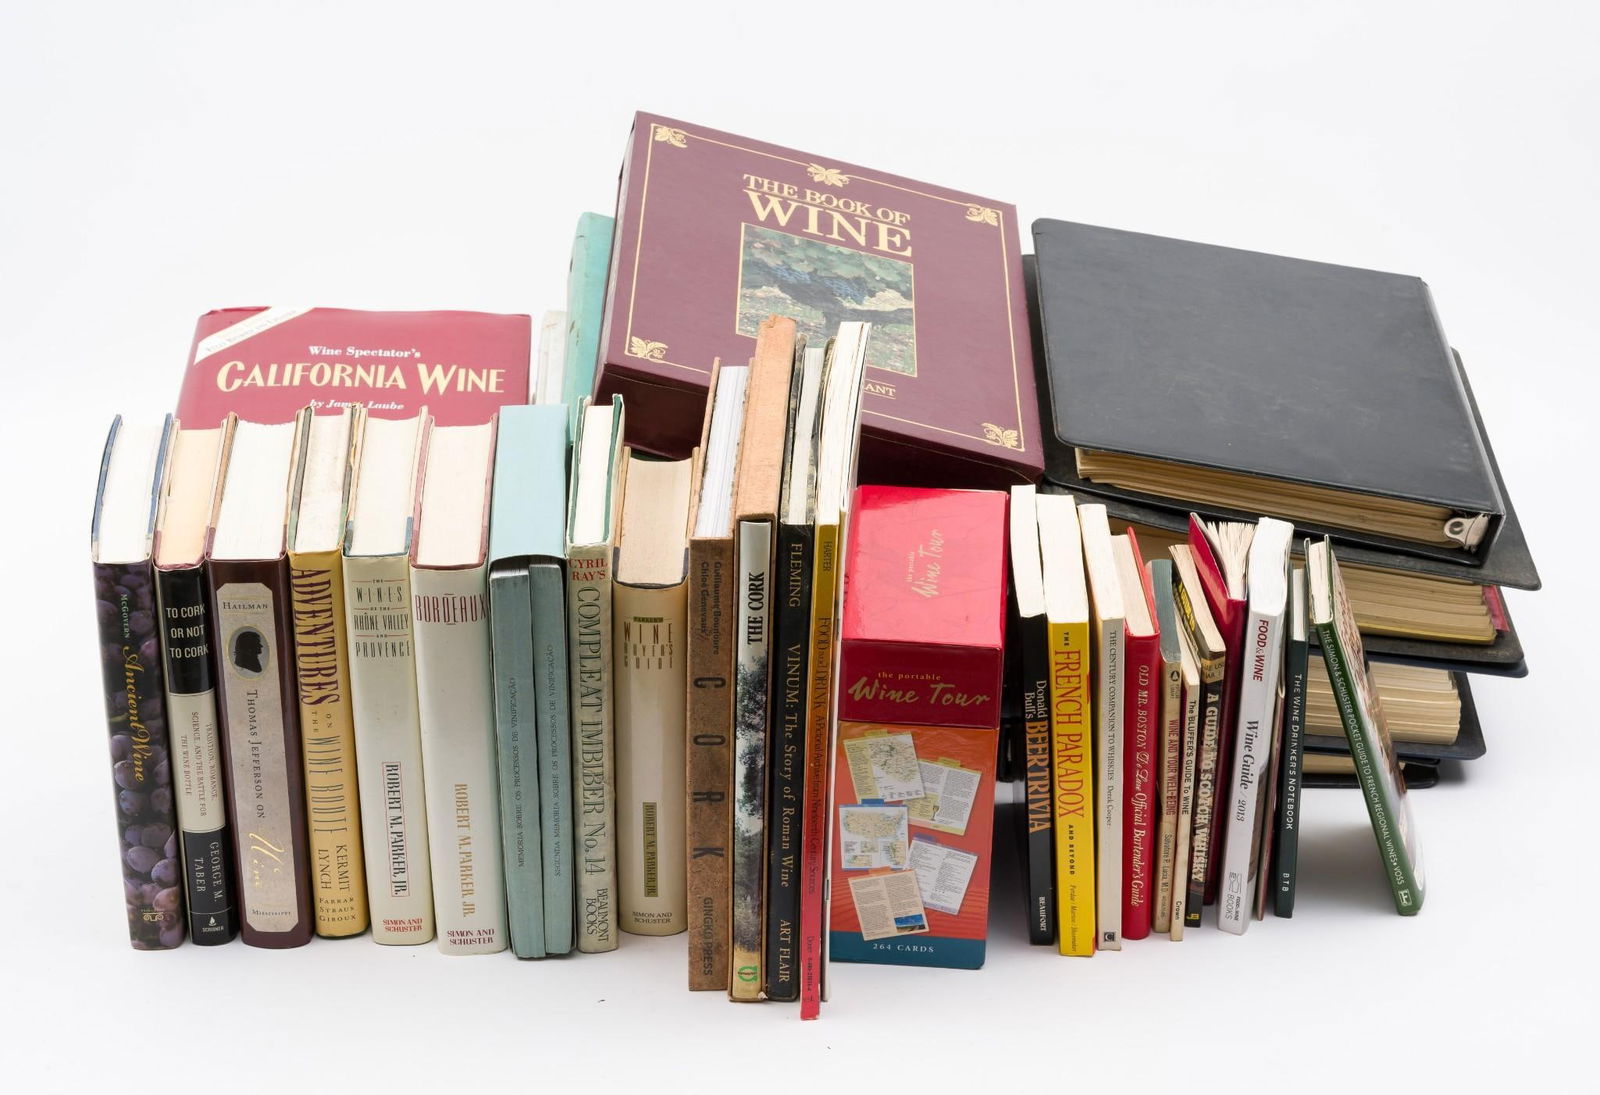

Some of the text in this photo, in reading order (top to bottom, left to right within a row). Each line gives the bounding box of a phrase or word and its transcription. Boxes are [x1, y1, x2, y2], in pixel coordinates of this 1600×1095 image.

[743, 174, 910, 227] THE BOOK OF
[743, 188, 912, 257] WINE
[308, 346, 420, 358] Wine Spectator's
[217, 361, 506, 395] CALIFORNIA WINE
[310, 400, 404, 410] by Laube
[568, 558, 608, 568] CYRIL
[823, 541, 832, 572] HARTER
[912, 529, 944, 598] Wine Tour
[572, 570, 606, 581] RAY'S
[166, 604, 206, 618] TO CORK
[222, 602, 268, 610] HAILMAN
[354, 612, 409, 631] RHÔNE VALLEY
[415, 594, 486, 623] BORDEAUX
[747, 572, 765, 646] THE CORK
[170, 625, 205, 639] OR NOT
[291, 568, 340, 706] ADVENTURES
[624, 622, 672, 644] WINE
[170, 644, 210, 659] TO CORK
[356, 641, 410, 658] PROVENCE
[624, 644, 673, 657] BUYER'S
[624, 656, 672, 670] GUIDE
[814, 618, 831, 710] FOOD DRINK
[1253, 620, 1268, 682] FOOD&WINE
[848, 677, 990, 706] Wine Tour
[898, 672, 941, 681] portable
[122, 645, 153, 782] Ancient Wine
[1025, 692, 1036, 720] Bull's
[1036, 680, 1048, 718] Donald
[1108, 686, 1116, 730] COMPANION
[1207, 692, 1219, 704] A
[577, 586, 606, 876] COMPLEAT IMBIBER No. 14
[780, 544, 802, 888] FLEMING VINUM: The Story of Roman Wine
[1204, 706, 1218, 746] GUIDE
[1055, 650, 1084, 818] FRENCH PARADOX
[1108, 734, 1115, 744] TO
[1168, 720, 1179, 776] WINE AND YOUR
[194, 744, 202, 760] AND
[246, 690, 265, 818] THOMAS JEFFERSON ON
[508, 677, 524, 829] SOBRE PROCESSOS DE VINIFICAÇÃO
[548, 645, 562, 877] SEGUNDA SOBRE PROCESSOS DE VINIFICAÇÃO
[1182, 700, 1196, 815] The BLUFFER'S GUIDE WINE
[1286, 674, 1302, 830] THE WINE DRINKER'S NOTEBOOK
[1322, 630, 1404, 886] THE SIMON SCHUSTER POCKET GUIDE FRENCH REGIONAL VOSS
[184, 770, 192, 795] BOTTLE
[306, 735, 348, 834] WINE ROUTE
[1130, 664, 1149, 908] OLD MR. BOSTON Official Bartender's Guide
[1236, 720, 1259, 822] Wine Guide 2013
[1106, 804, 1114, 826] Cooper
[1196, 772, 1214, 825] SCOTCH
[386, 764, 408, 896] ROBERT M. PARKER, JR.
[646, 804, 654, 835] ROBERT
[210, 841, 222, 888] GEORGE
[336, 844, 350, 892] KERMIT
[454, 784, 476, 918] ROBERT M. JR.
[1068, 844, 1076, 875] BEYOND
[194, 858, 206, 892] TABER
[318, 849, 332, 890] LYNCH
[1282, 872, 1290, 892] BTB
[319, 896, 354, 904] FARRAR
[320, 906, 354, 914] STRAUS
[586, 898, 598, 935] BOOKS
[596, 888, 608, 942] BEAUMONT
[1225, 894, 1234, 920] BOOKS
[319, 914, 356, 922] GIROUX
[406, 918, 422, 926] AND
[447, 928, 494, 938] SIMON AND
[450, 937, 494, 946] SCHUSTER
[779, 919, 791, 983] ART FLAIR
[898, 944, 934, 952] CARDS
